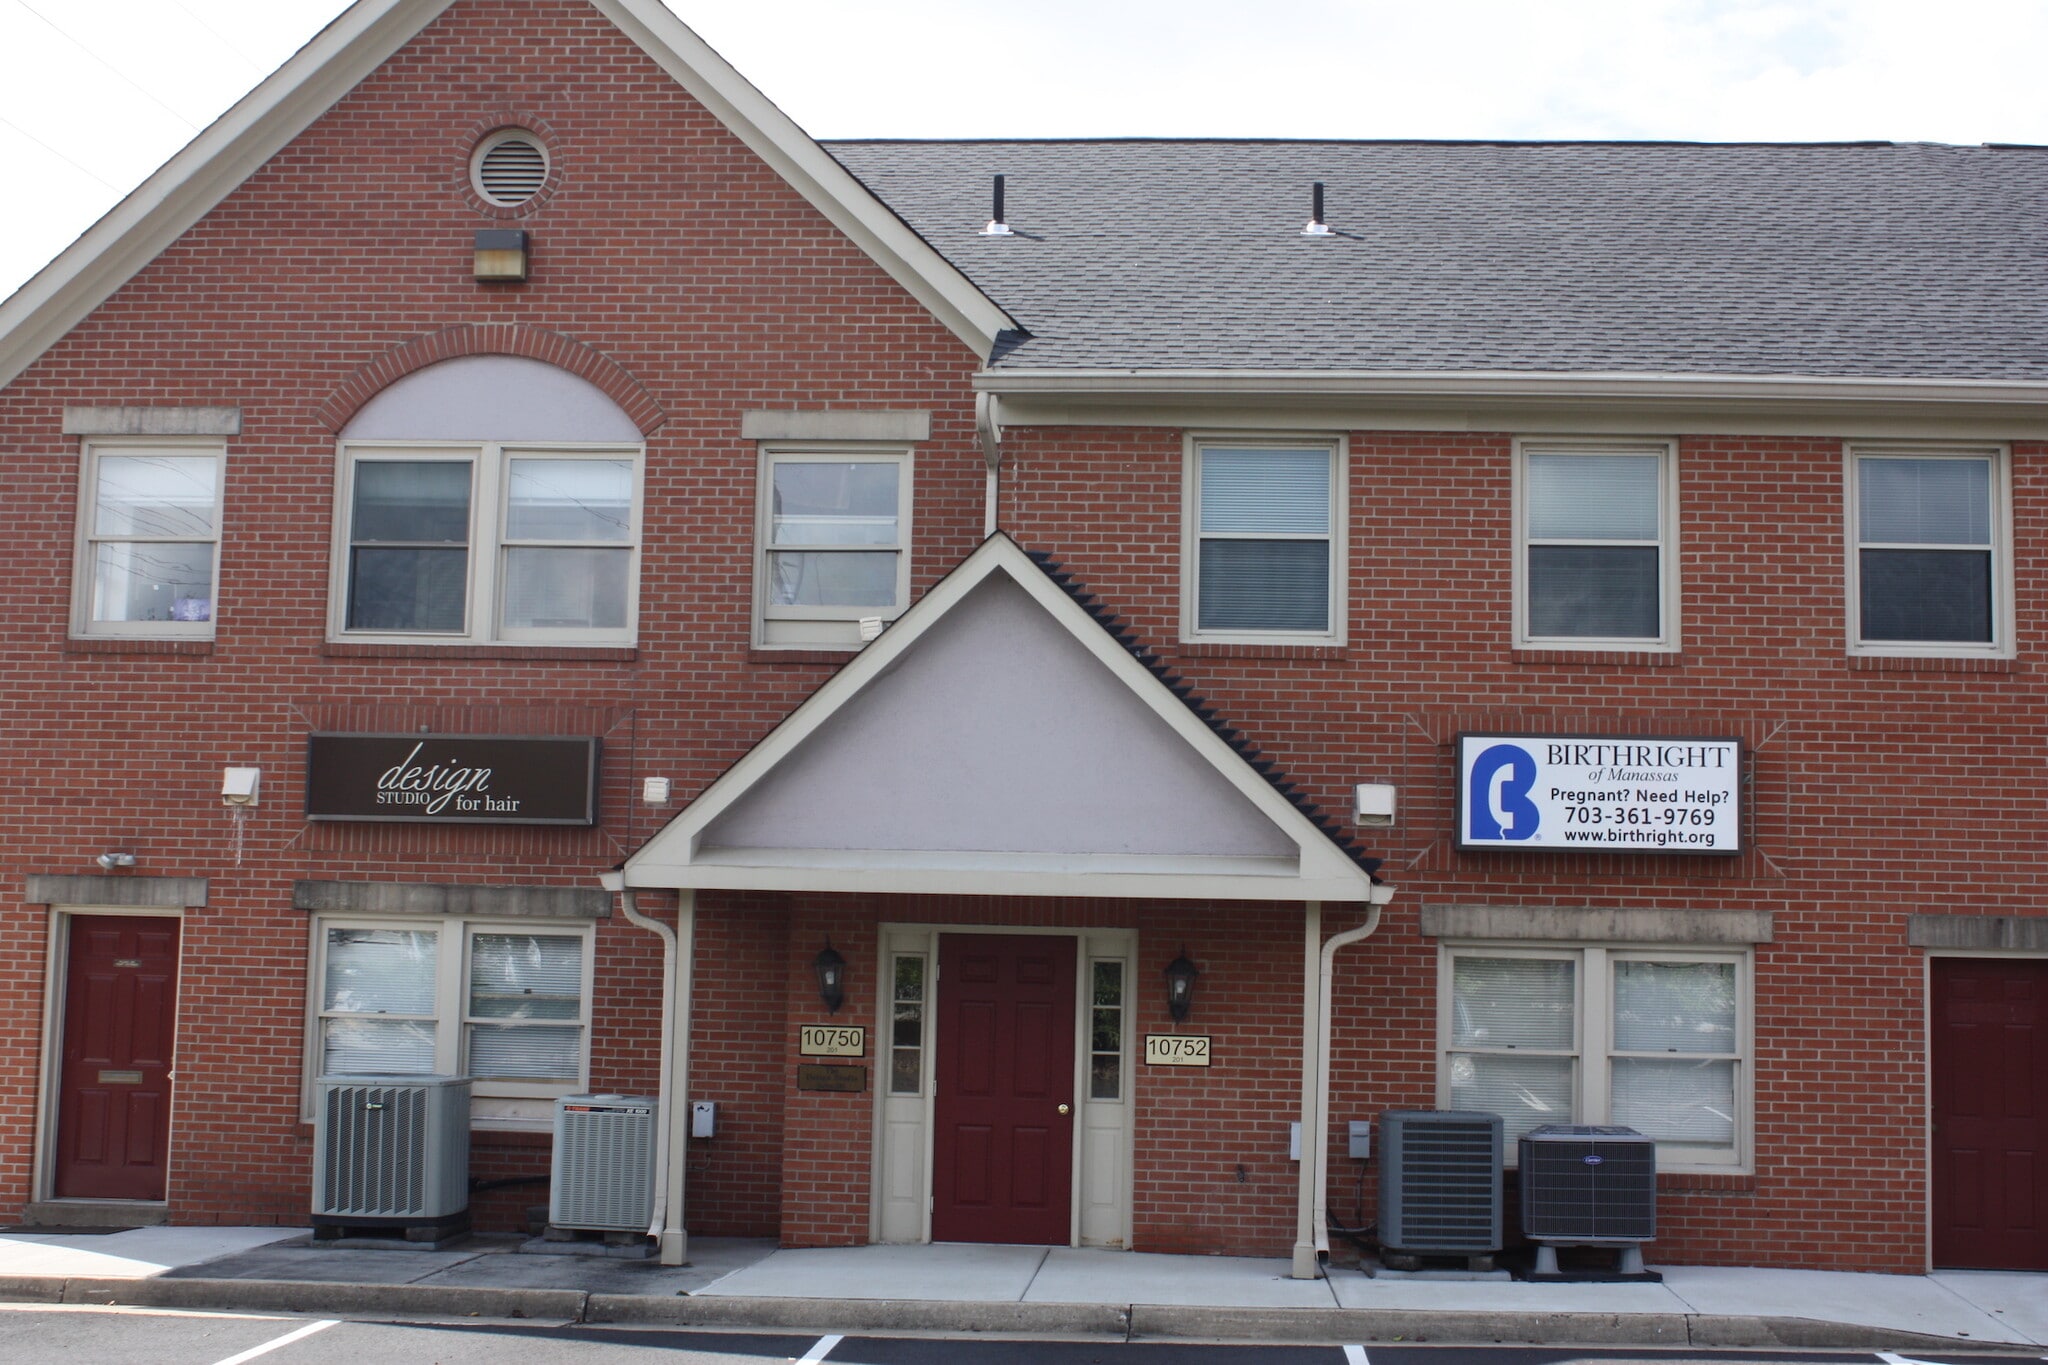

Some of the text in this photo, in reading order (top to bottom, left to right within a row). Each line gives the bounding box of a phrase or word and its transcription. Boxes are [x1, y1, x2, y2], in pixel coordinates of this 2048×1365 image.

[1546, 744, 1730, 768] BIRTHRIGHT
[377, 741, 492, 815] design
[1588, 767, 1679, 783] of Manassas
[376, 791, 520, 811] STUDIO for hair
[1550, 788, 1730, 806] Pregnant? Need Help?
[1565, 806, 1715, 826] 703-361-9769
[1564, 828, 1715, 847] www.birthright.org
[803, 1029, 860, 1047] 10750
[1148, 1039, 1207, 1056] 10752
